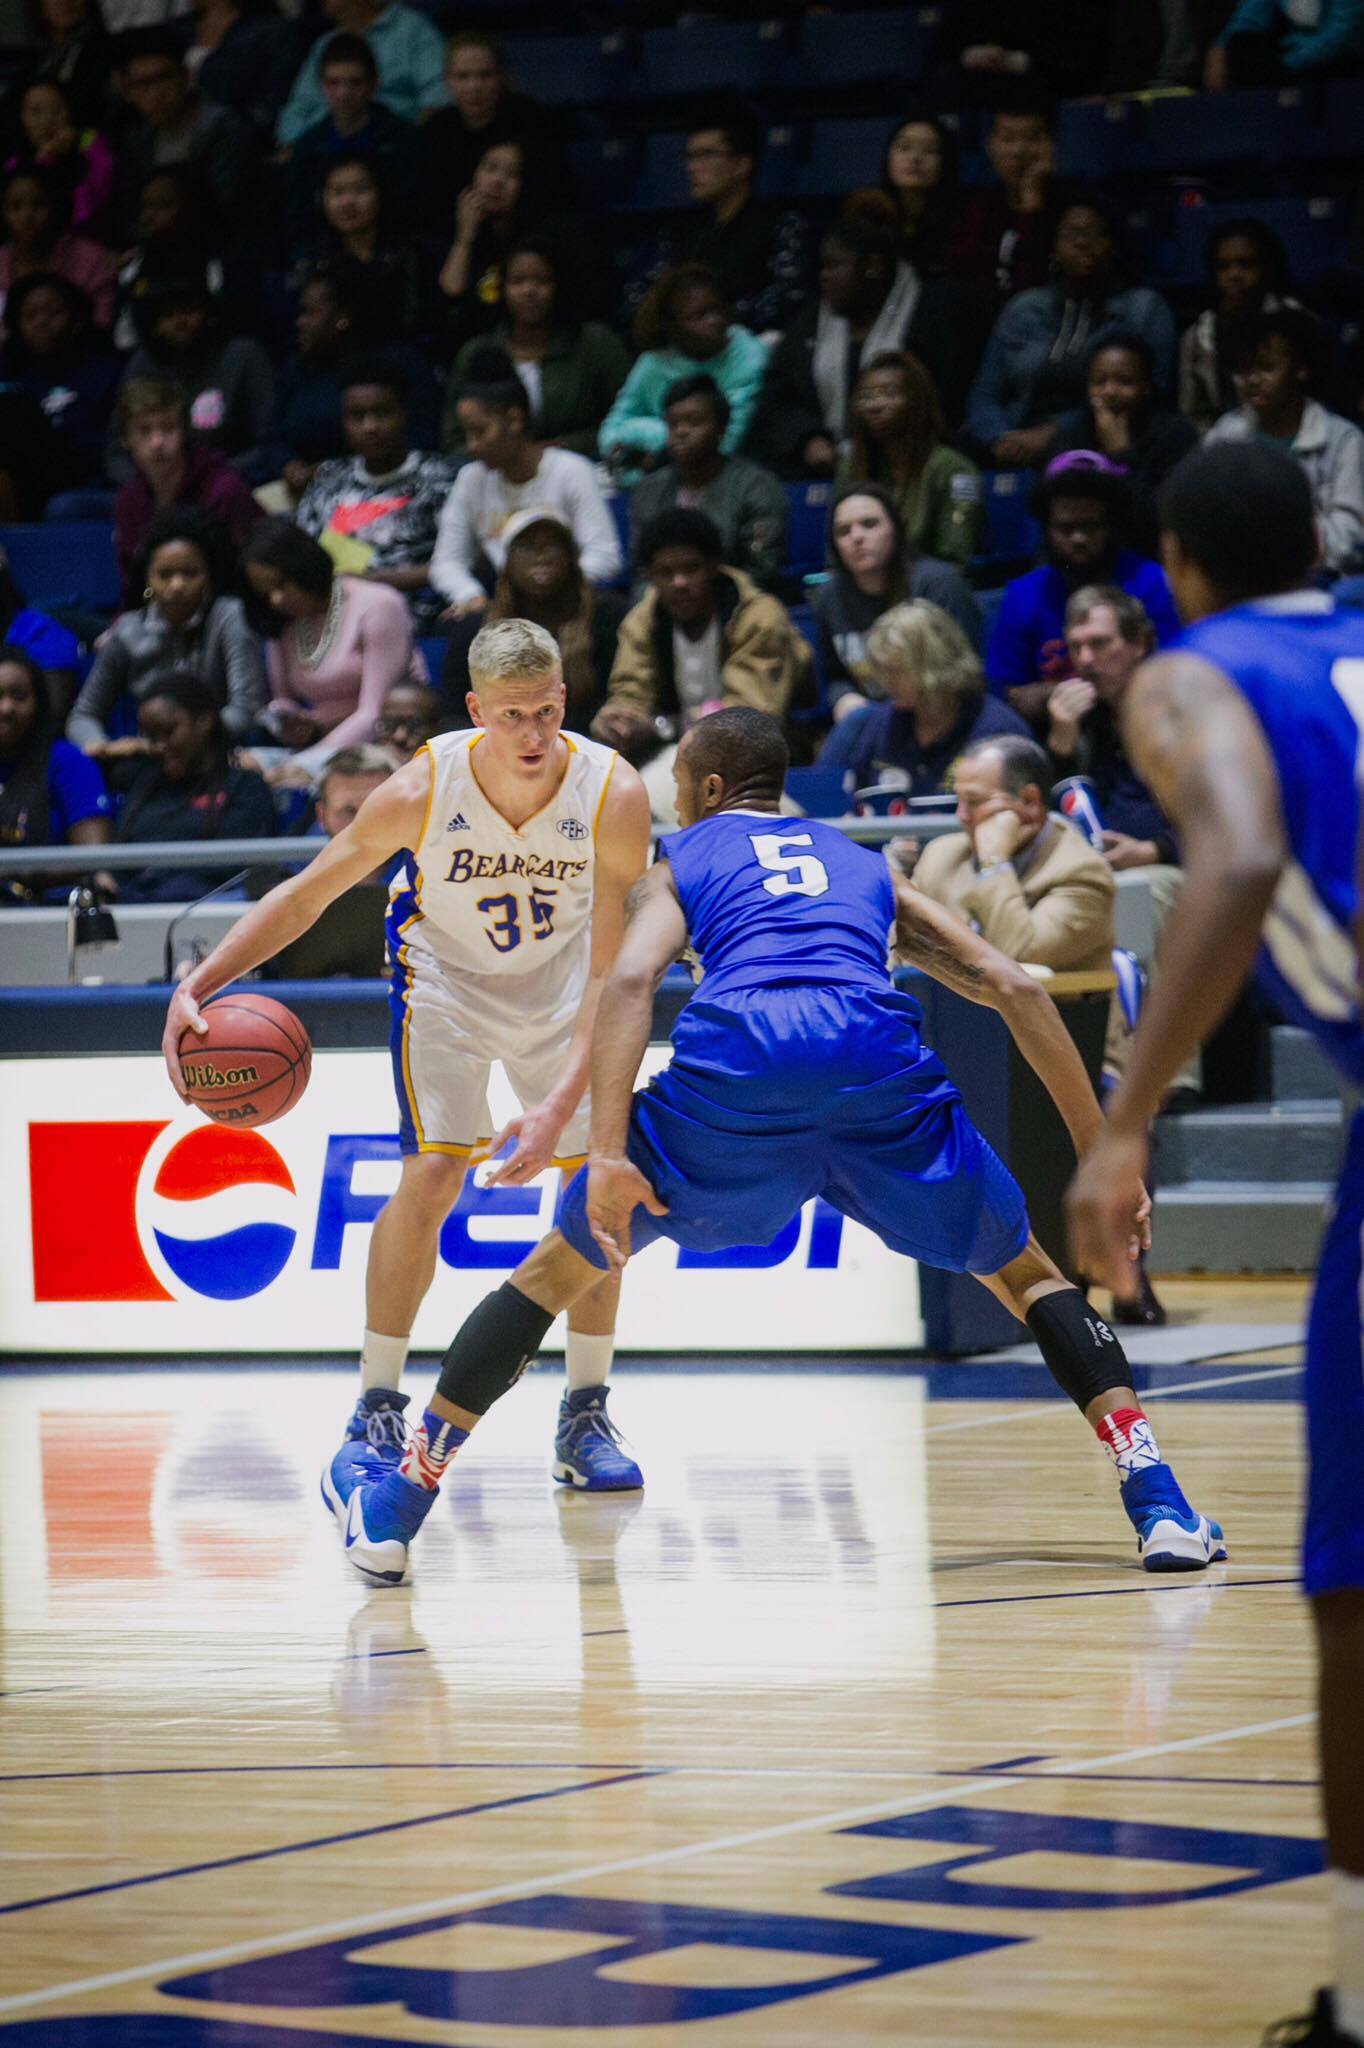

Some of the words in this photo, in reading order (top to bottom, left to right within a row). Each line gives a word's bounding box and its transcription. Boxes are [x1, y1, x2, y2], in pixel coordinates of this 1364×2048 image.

[561, 820, 584, 838] FEH
[747, 833, 830, 897] 5
[476, 885, 559, 953] 35
[180, 1064, 259, 1088] Wilson
